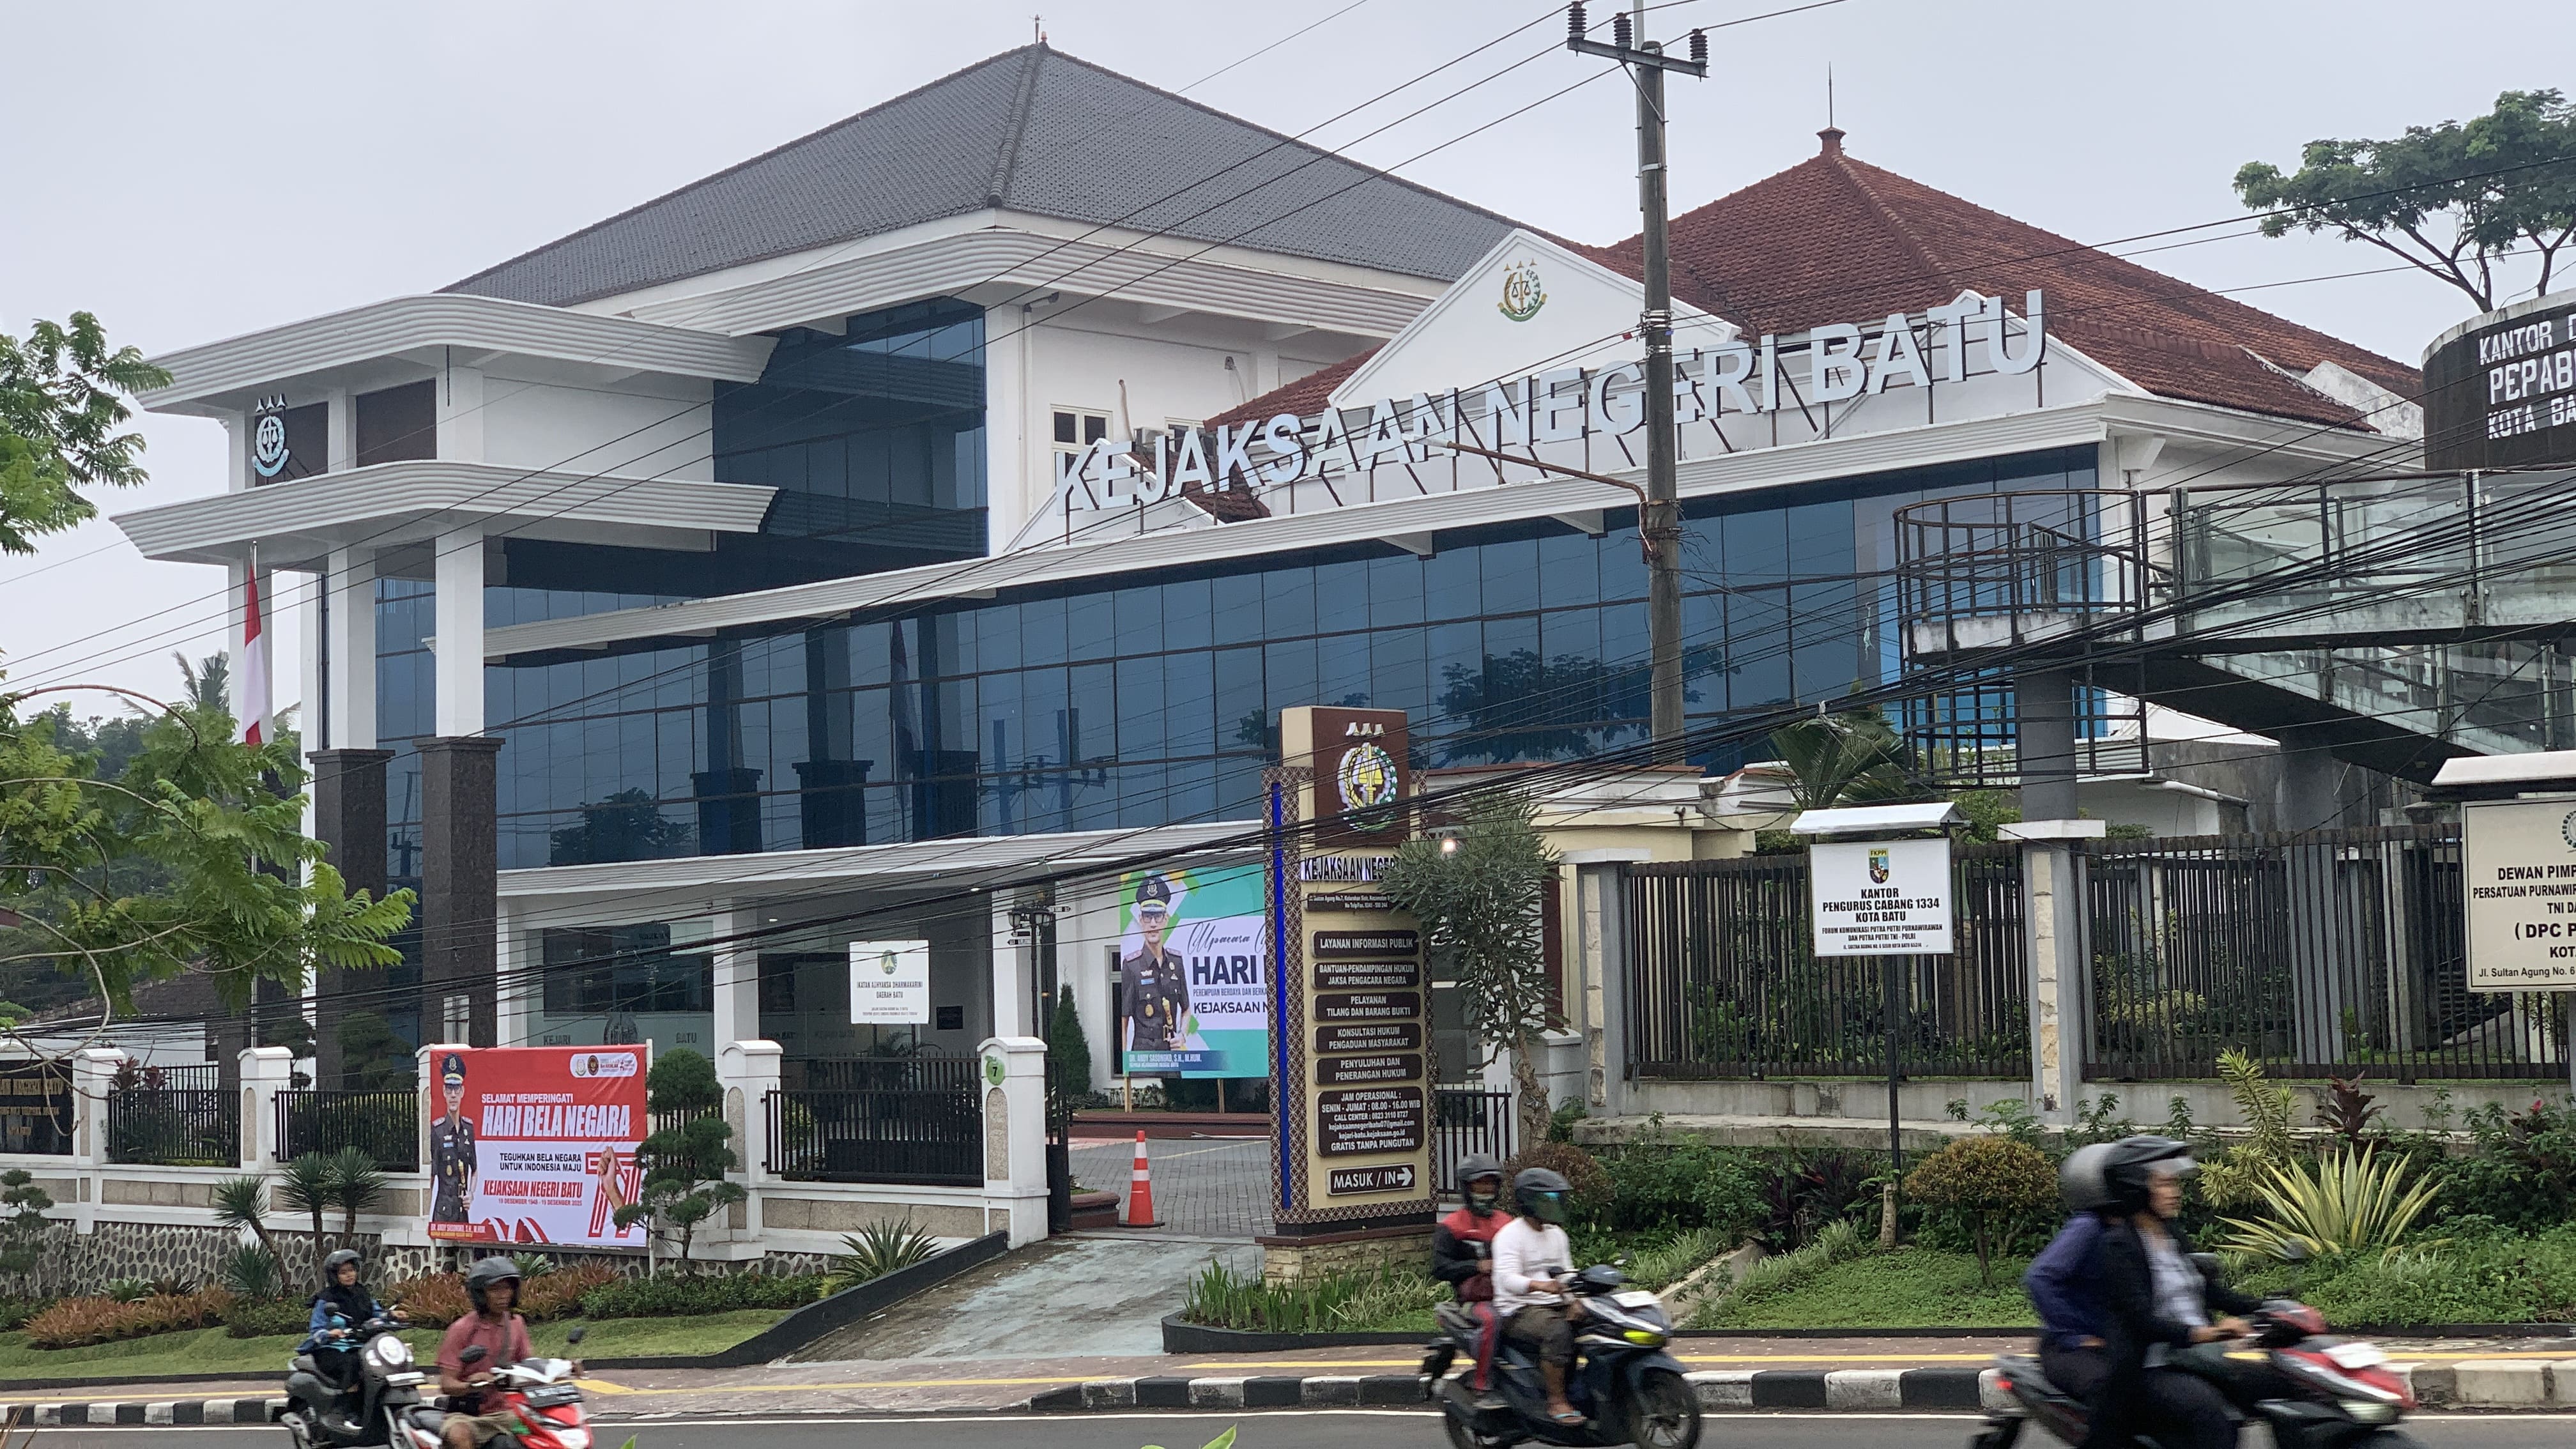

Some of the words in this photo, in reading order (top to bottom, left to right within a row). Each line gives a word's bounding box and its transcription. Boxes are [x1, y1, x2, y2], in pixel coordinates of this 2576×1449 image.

[2479, 320, 2552, 365] KANTOR
[1055, 386, 1458, 515] KEJAKSAAN
[1485, 334, 1778, 451] NEGERI
[1811, 289, 2046, 404] BATU
[2487, 404, 2536, 440] KOTA
[1305, 857, 1363, 880] KEJAKSAAN
[1365, 857, 1395, 880] NEGE
[2497, 866, 2543, 880] DEWAN
[1860, 887, 1899, 899] KANTOR
[2473, 885, 2526, 899] PERSATUAN
[1822, 900, 1872, 912] PENGURUS
[1874, 899, 1913, 910] CABANG
[1915, 898, 1940, 908] 1334
[2547, 902, 2564, 914] TNI
[1855, 912, 1880, 923] KOTA
[1882, 911, 1906, 922] BATU
[2526, 923, 2561, 938] DPC
[1187, 923, 1250, 954] Upacara
[1320, 939, 1351, 949] LAYANAN
[1352, 938, 1388, 949] INFORMASI
[1390, 938, 1413, 947] PUBLIK
[1193, 954, 1257, 985] HARI
[1319, 965, 1393, 973] BANTUAN-PENDAMPINGAN
[2479, 968, 2489, 977] Jl.
[2491, 967, 2519, 977] Sultan
[2521, 967, 2550, 979] Agung
[2552, 967, 2567, 976] No.
[2570, 967, 2575, 975] 6
[1328, 976, 1347, 985] JAKSA
[1348, 976, 1383, 985] PENGACARA
[1383, 976, 1406, 985] NEGARA
[1193, 988, 1220, 997] PEREMPUAN
[1221, 988, 1241, 996] BERDAYA
[1242, 987, 1252, 996] DAN
[1351, 995, 1386, 1004] PELAYANAN
[1193, 1000, 1261, 1015] KEJAKSAAN
[1326, 1008, 1349, 1016] TILANG
[1351, 1008, 1364, 1016] DAN
[1365, 1008, 1390, 1016] BARANG
[1392, 1007, 1411, 1016] BUKTI
[1337, 1027, 1376, 1038] KONSULTASI
[1377, 1026, 1400, 1036] HUKUM
[1329, 1039, 1367, 1050] PENGADUAN
[1368, 1037, 1409, 1048] MASYARAKAT
[1340, 1059, 1386, 1069] PENYULUHAN
[1386, 1057, 1400, 1066] DAN
[992, 1066, 997, 1077] 7
[1335, 1070, 1381, 1081] PENERANGAN
[1382, 1069, 1406, 1078] HUKUM
[482, 1094, 515, 1103] SELAMAT
[516, 1093, 573, 1103] MEMPERINGATI
[1341, 1092, 1354, 1102] JAM
[1355, 1091, 1398, 1101] OPERASIONAL
[1321, 1104, 1341, 1113] SENIN
[1346, 1102, 1367, 1112] JUMAT
[1371, 1101, 1388, 1110] 08.00
[1392, 1101, 1408, 1109] 16.00
[1409, 1100, 1421, 1108] WIB
[481, 1105, 521, 1136] HARI
[523, 1105, 563, 1137] BELA
[564, 1105, 630, 1137] NEGARA
[1331, 1142, 1355, 1151] GRATIS
[1356, 1140, 1378, 1150] TANPA
[1379, 1138, 1414, 1149] PUNGUTAN
[500, 1153, 535, 1162] TEGUHKAN
[537, 1153, 553, 1162] BELA
[555, 1153, 581, 1162] NEGARA
[500, 1163, 523, 1171] UNTUK
[525, 1163, 561, 1172] INDONESIA
[562, 1163, 581, 1172] MAJU
[1334, 1172, 1373, 1189] MASUK
[1376, 1170, 1381, 1188] /
[1384, 1170, 1396, 1185] IN
[483, 1181, 529, 1196] KEJAKSAAN
[530, 1181, 560, 1197] NEGERI
[561, 1182, 583, 1197] BATU
